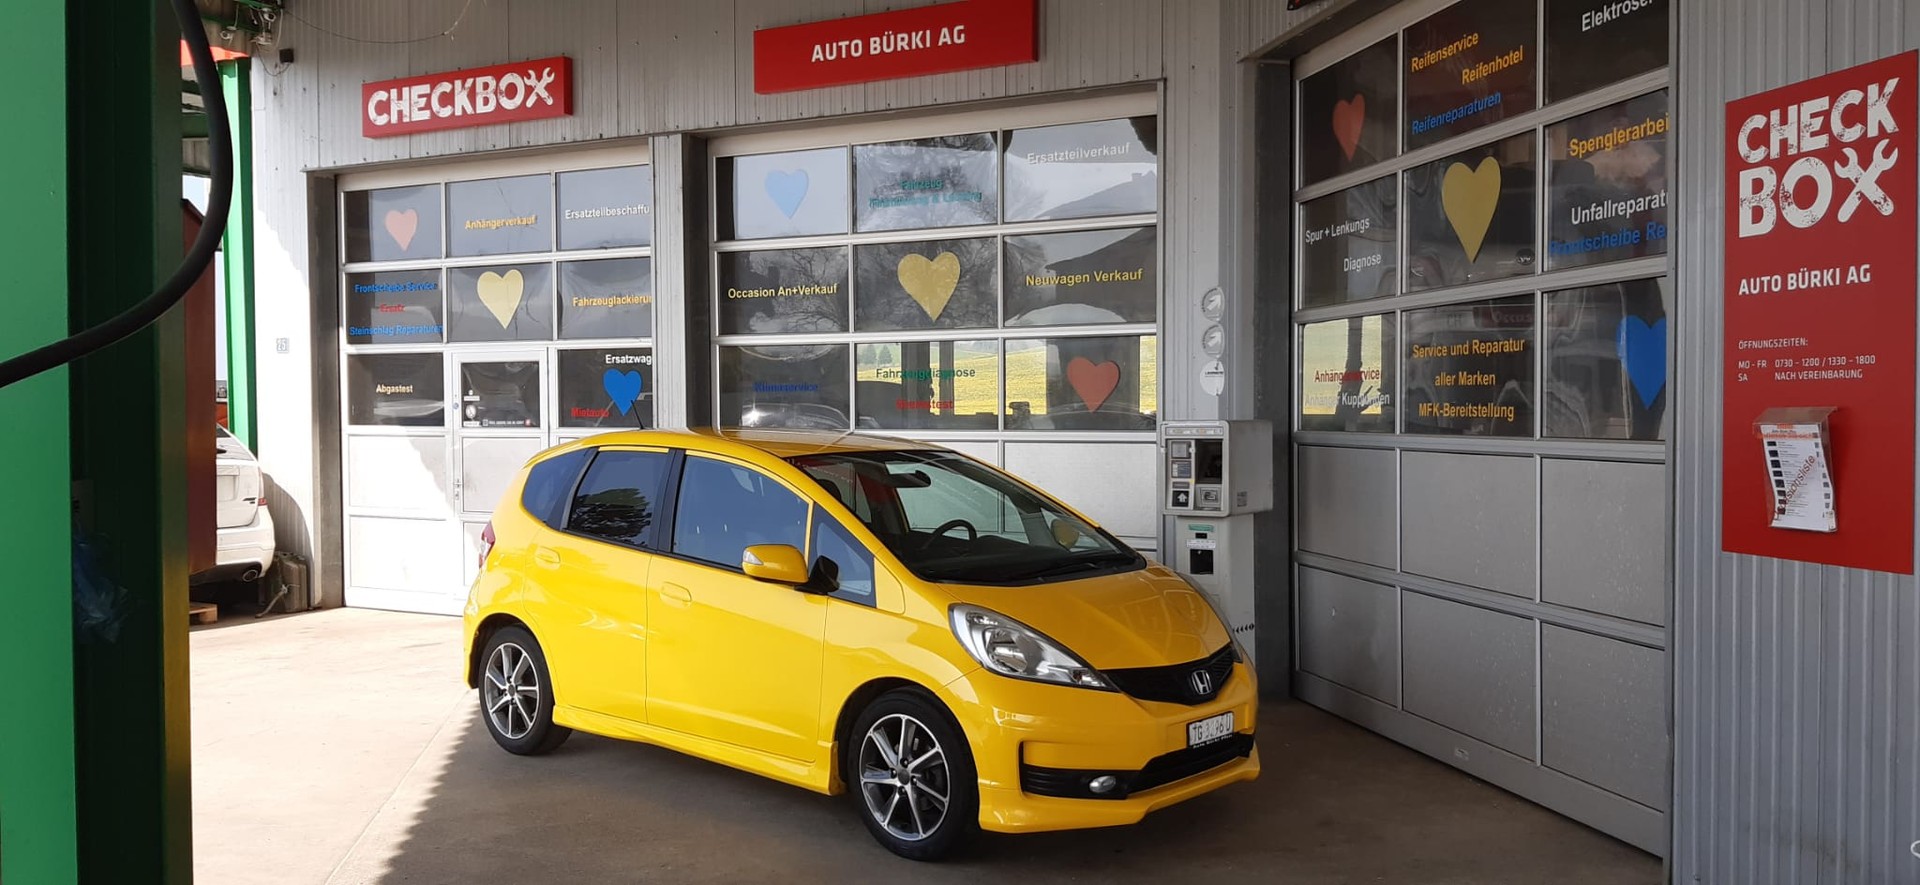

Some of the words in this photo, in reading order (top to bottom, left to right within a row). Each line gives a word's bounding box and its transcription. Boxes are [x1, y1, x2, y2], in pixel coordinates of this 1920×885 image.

[811, 39, 863, 63] AUTO
[869, 31, 931, 55] BÜRKI
[938, 25, 966, 46] AG
[1411, 32, 1479, 72] Reifenservice
[1462, 45, 1523, 85] Reifenhotel
[367, 66, 556, 126] CHECKBOX
[1412, 92, 1502, 135] Reifenreparaturen
[1738, 77, 1899, 164] CHECK
[1569, 113, 1669, 158] Spenglerarbei
[1027, 141, 1131, 165] Ersatzteilverkauf
[1738, 138, 1899, 238] BOX
[565, 204, 650, 220] Ersatzteilbeschaffu
[465, 214, 538, 231] Anhängerverkauf
[1306, 230, 1323, 245] Spur
[1325, 227, 1330, 237] +
[1331, 218, 1370, 237] Lenkungs
[1344, 254, 1382, 272] Diagnose
[1026, 272, 1091, 287] Neuwagen
[1094, 268, 1143, 283] Verkauf
[1739, 275, 1781, 296] AUTO
[1787, 268, 1840, 291] BÜRKI
[1846, 264, 1870, 284] AG
[355, 282, 405, 293] Frontscheibe
[728, 286, 776, 299] Occasion
[777, 283, 839, 298] An+Verkauf
[349, 325, 394, 337] Steinschlag
[1413, 344, 1448, 358] Service
[1450, 340, 1469, 355] und
[1472, 338, 1525, 357] Reparatur
[1738, 337, 1808, 350] ÖFFNUNGSZEITEN:
[606, 354, 652, 365] Ersatzwag
[1738, 360, 1750, 369] MO
[1757, 359, 1767, 368] FR
[1775, 359, 1793, 368] 0730
[1802, 357, 1820, 367] 1200
[1828, 355, 1846, 366] 1330
[1855, 354, 1876, 365] 1800
[876, 367, 976, 380] Fahrzeugdiagnose
[1314, 367, 1380, 384] Anhängrvice
[1435, 372, 1456, 386] aller
[1458, 371, 1496, 386] Marken
[1738, 374, 1748, 382] SA
[1775, 371, 1796, 381] NACH
[1798, 368, 1863, 380] VEREINBARUNG
[376, 384, 413, 395] Abgastest
[1419, 402, 1514, 422] MFK-Bereitstellung
